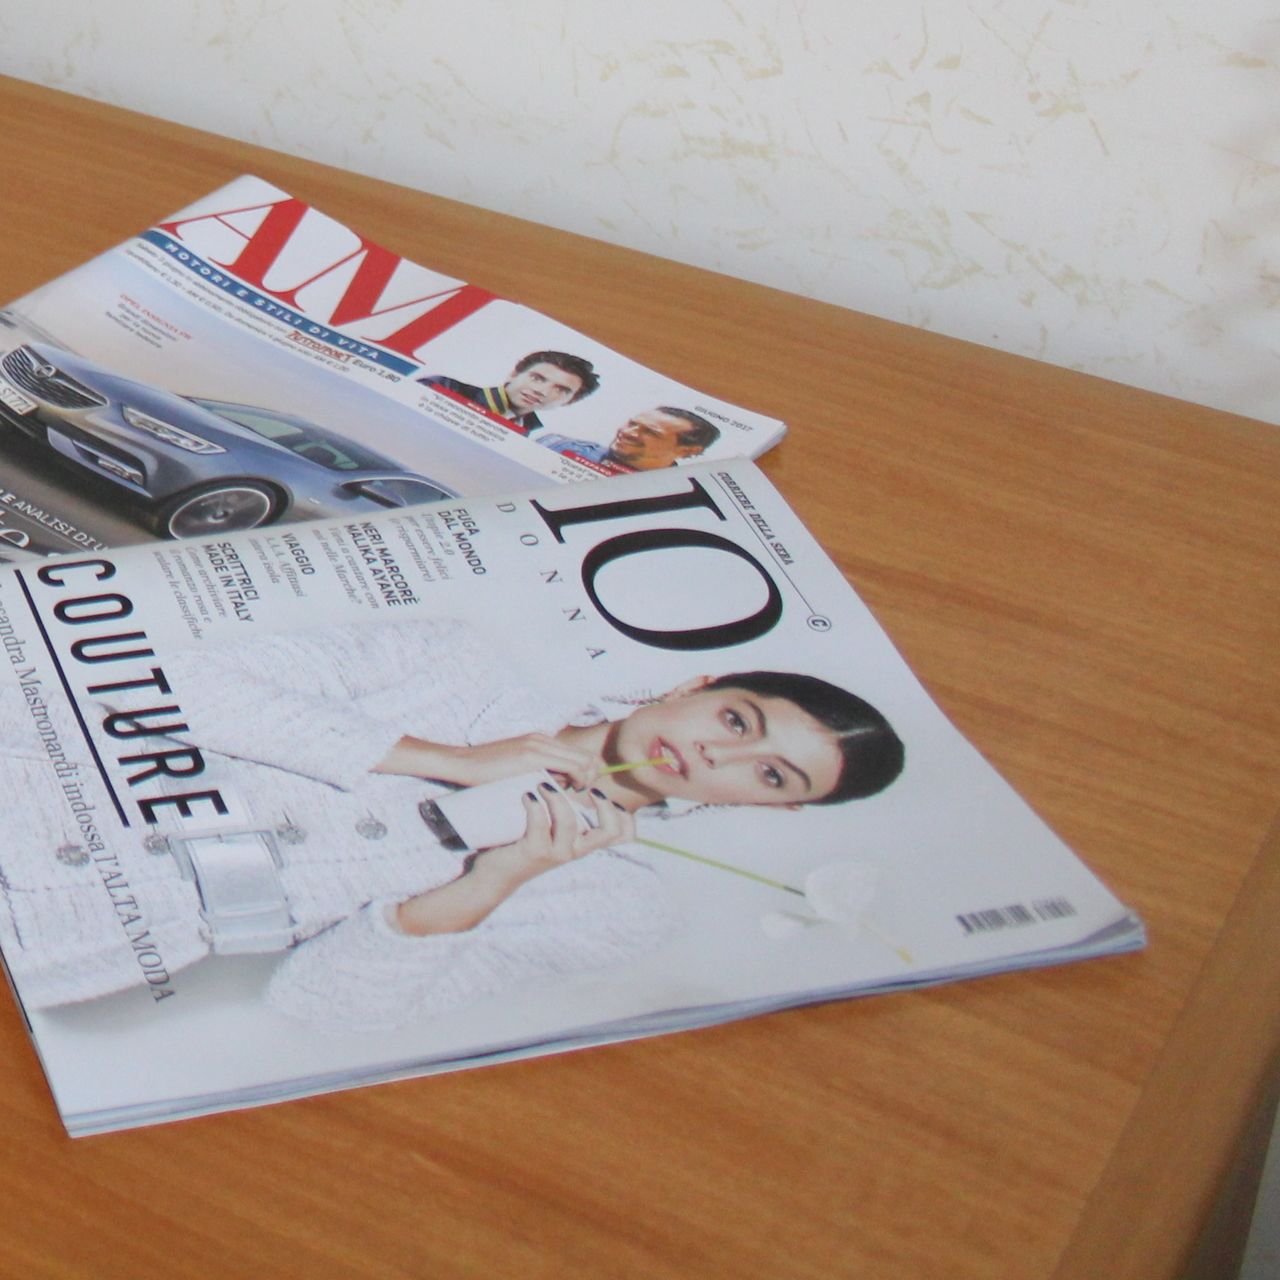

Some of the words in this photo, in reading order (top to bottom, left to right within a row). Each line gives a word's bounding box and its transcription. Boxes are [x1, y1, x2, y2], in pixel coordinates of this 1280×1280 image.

[165, 242, 231, 288] MOTORI
[254, 298, 302, 326] STILI
[308, 325, 330, 339] DI
[338, 338, 379, 360] VITA
[13, 500, 78, 538] ANALISI
[73, 531, 97, 548] DI
[437, 511, 459, 532] DAL
[451, 531, 487, 577] MONDO
[452, 508, 482, 537] FUGA
[717, 471, 756, 512] CORRIERE
[748, 508, 778, 542] DELLA
[770, 541, 795, 567] SERA
[201, 544, 230, 574] MADE
[217, 541, 260, 601] SCRITTRICI
[218, 573, 238, 589] IN
[281, 532, 316, 576] VIAGGIO
[343, 523, 377, 566] MALIKA
[370, 567, 403, 608] AYANE
[360, 521, 386, 547] NERI
[376, 546, 421, 607] MARCORÈ
[528, 477, 783, 651] IO
[172, 588, 205, 641] classifiche
[193, 593, 210, 619] rosa
[225, 589, 256, 623] ITALY
[37, 558, 230, 825] COUTURE
[14, 665, 80, 781] Mastronardi
[63, 782, 106, 854] indossa
[93, 854, 143, 934] l'ALTA
[125, 929, 177, 1004] MODA
